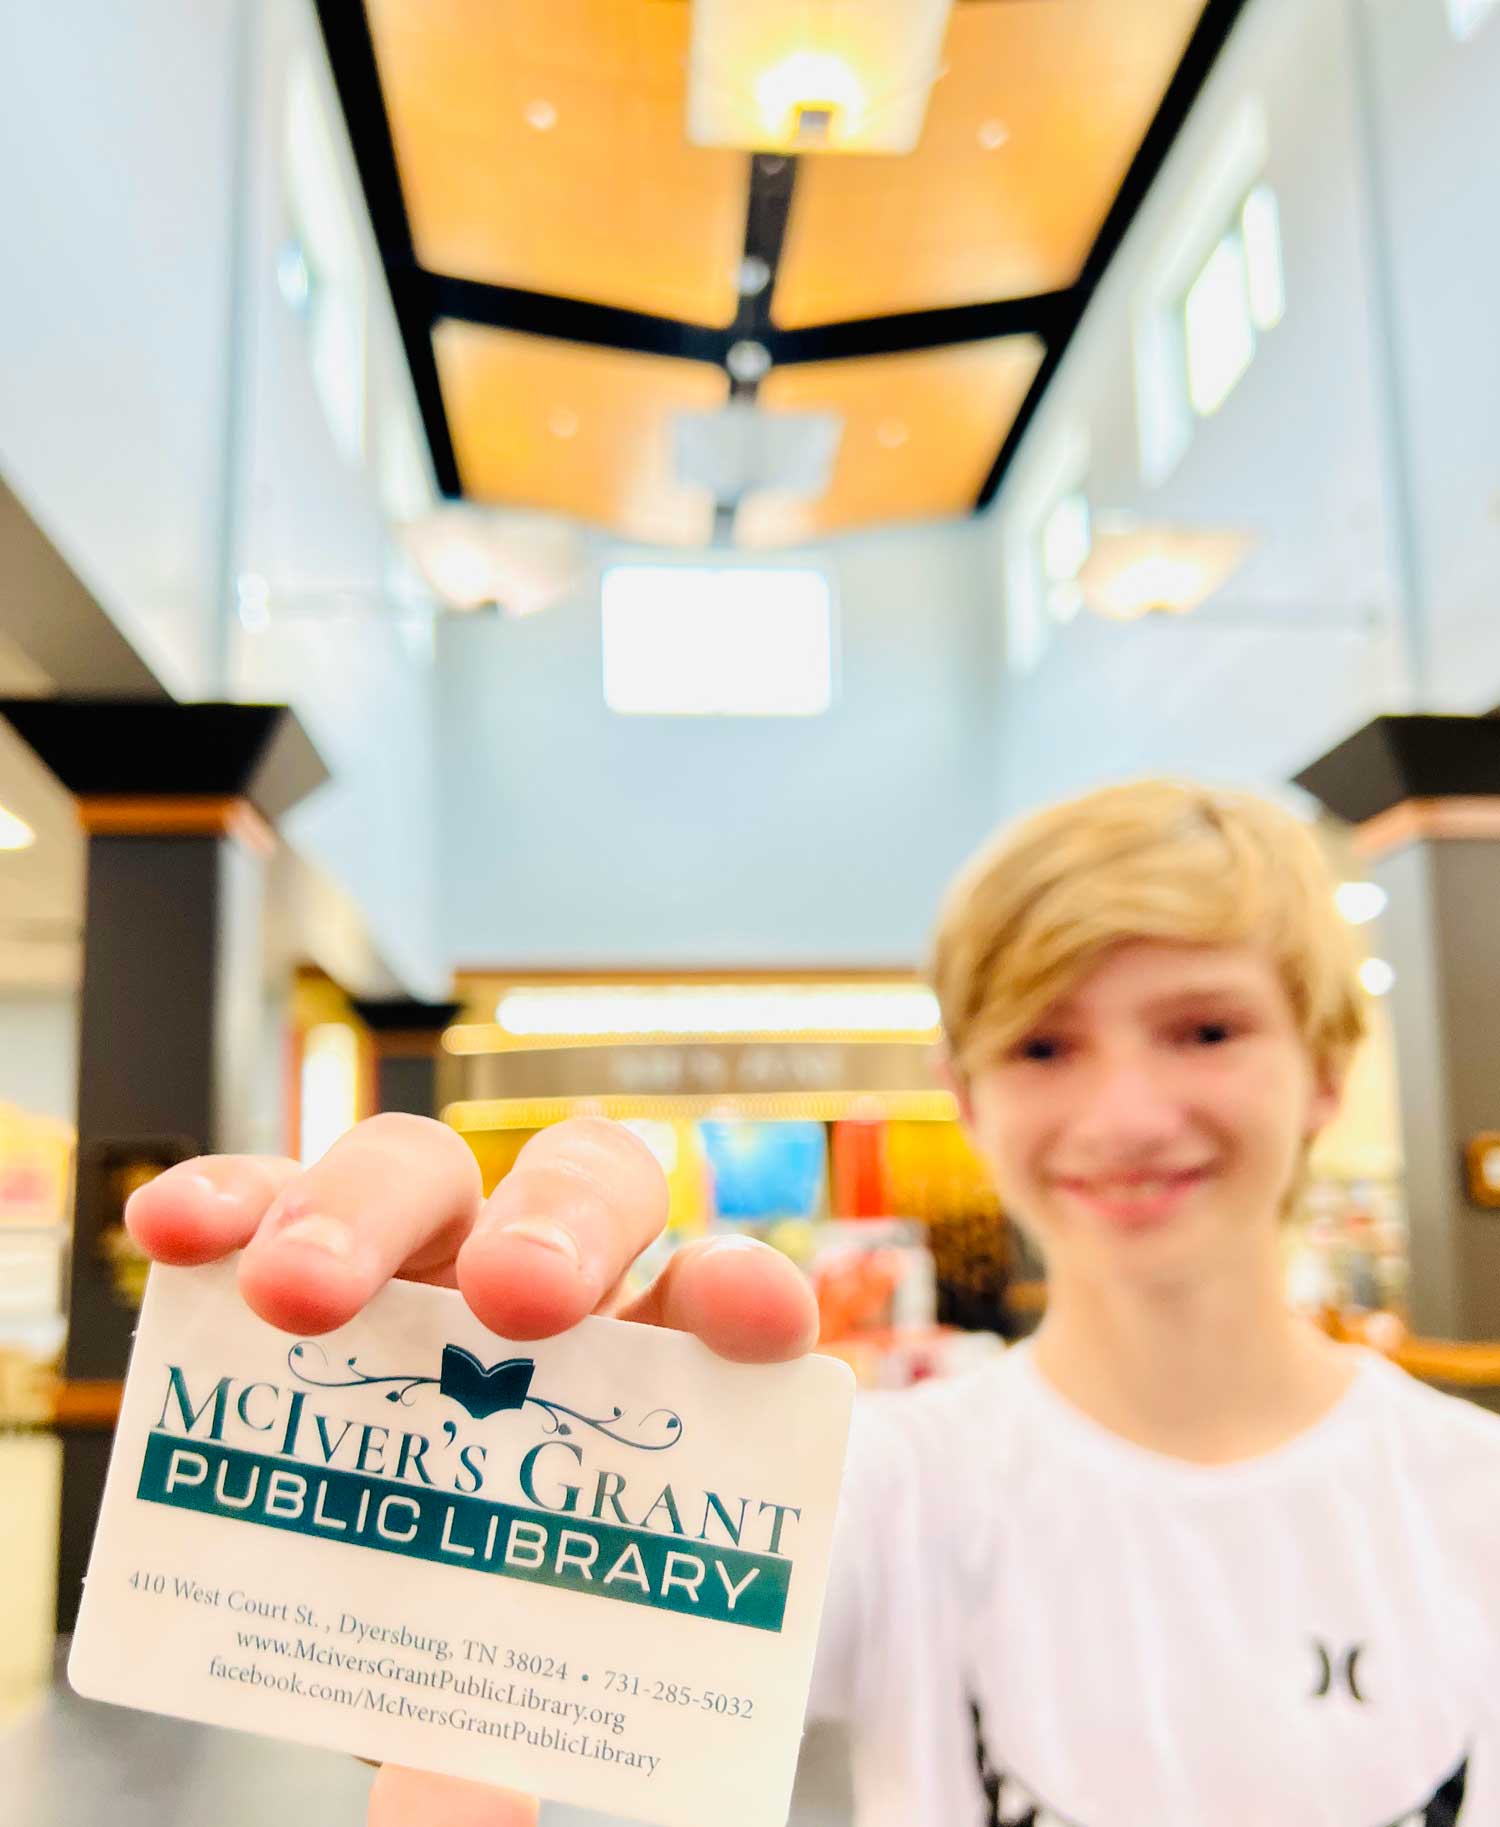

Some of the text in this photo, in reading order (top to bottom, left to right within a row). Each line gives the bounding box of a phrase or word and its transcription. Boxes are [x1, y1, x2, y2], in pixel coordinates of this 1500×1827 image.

[165, 1449, 760, 1610] PUBLIC LIBRARY
[519, 1439, 802, 1557] GRANT
[129, 1570, 165, 1594] 410
[174, 1576, 220, 1606] West
[227, 1590, 288, 1621] Court
[339, 1613, 454, 1662] Dyersburg,
[463, 1639, 499, 1666] TN
[504, 1649, 568, 1680] 38024
[604, 1670, 754, 1719] 731-285-5032
[237, 1631, 627, 1735] www.MciversGrantPublicLibrary.org
[209, 1656, 662, 1777] facebook.com/McIversGrantPublicLibrary
